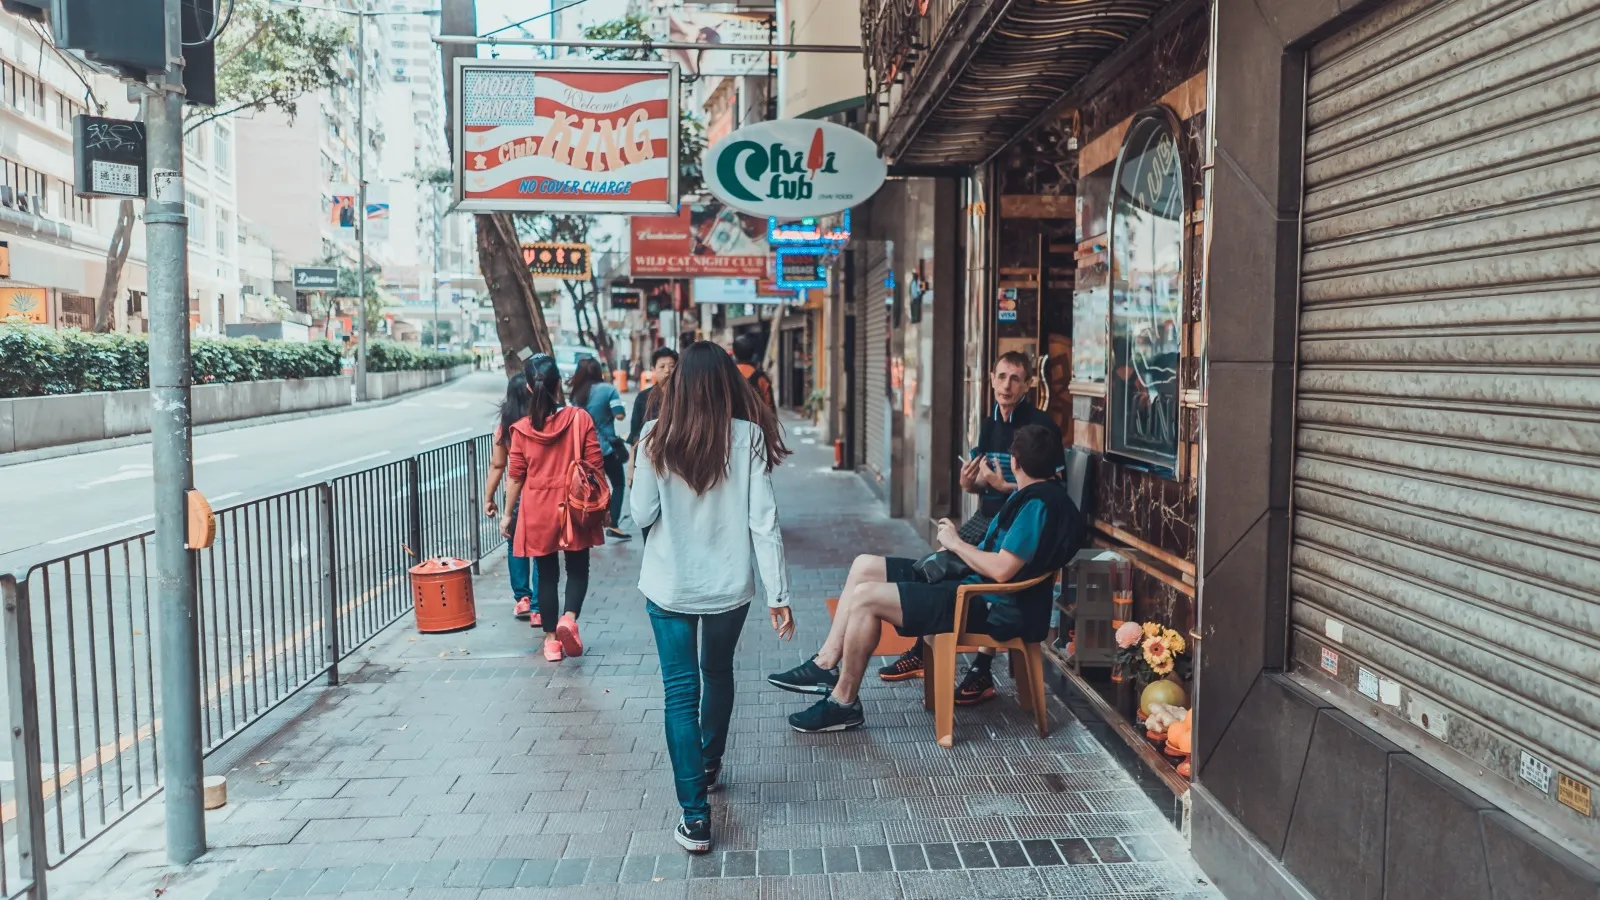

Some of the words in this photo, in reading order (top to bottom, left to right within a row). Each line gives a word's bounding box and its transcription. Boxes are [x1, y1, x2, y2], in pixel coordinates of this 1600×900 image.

[474, 76, 528, 96] MODEL
[563, 87, 619, 111] Welcome
[621, 93, 632, 105] to
[473, 100, 527, 120] DANCER
[498, 137, 537, 164] Club
[537, 108, 655, 172] KING
[519, 180, 536, 193] NO
[539, 179, 580, 194] COVER
[581, 181, 632, 194] CHARGE
[635, 255, 666, 266] WILD
[668, 255, 690, 266] CAT
[693, 256, 729, 267] NIGHT
[731, 256, 764, 267] CLUB
